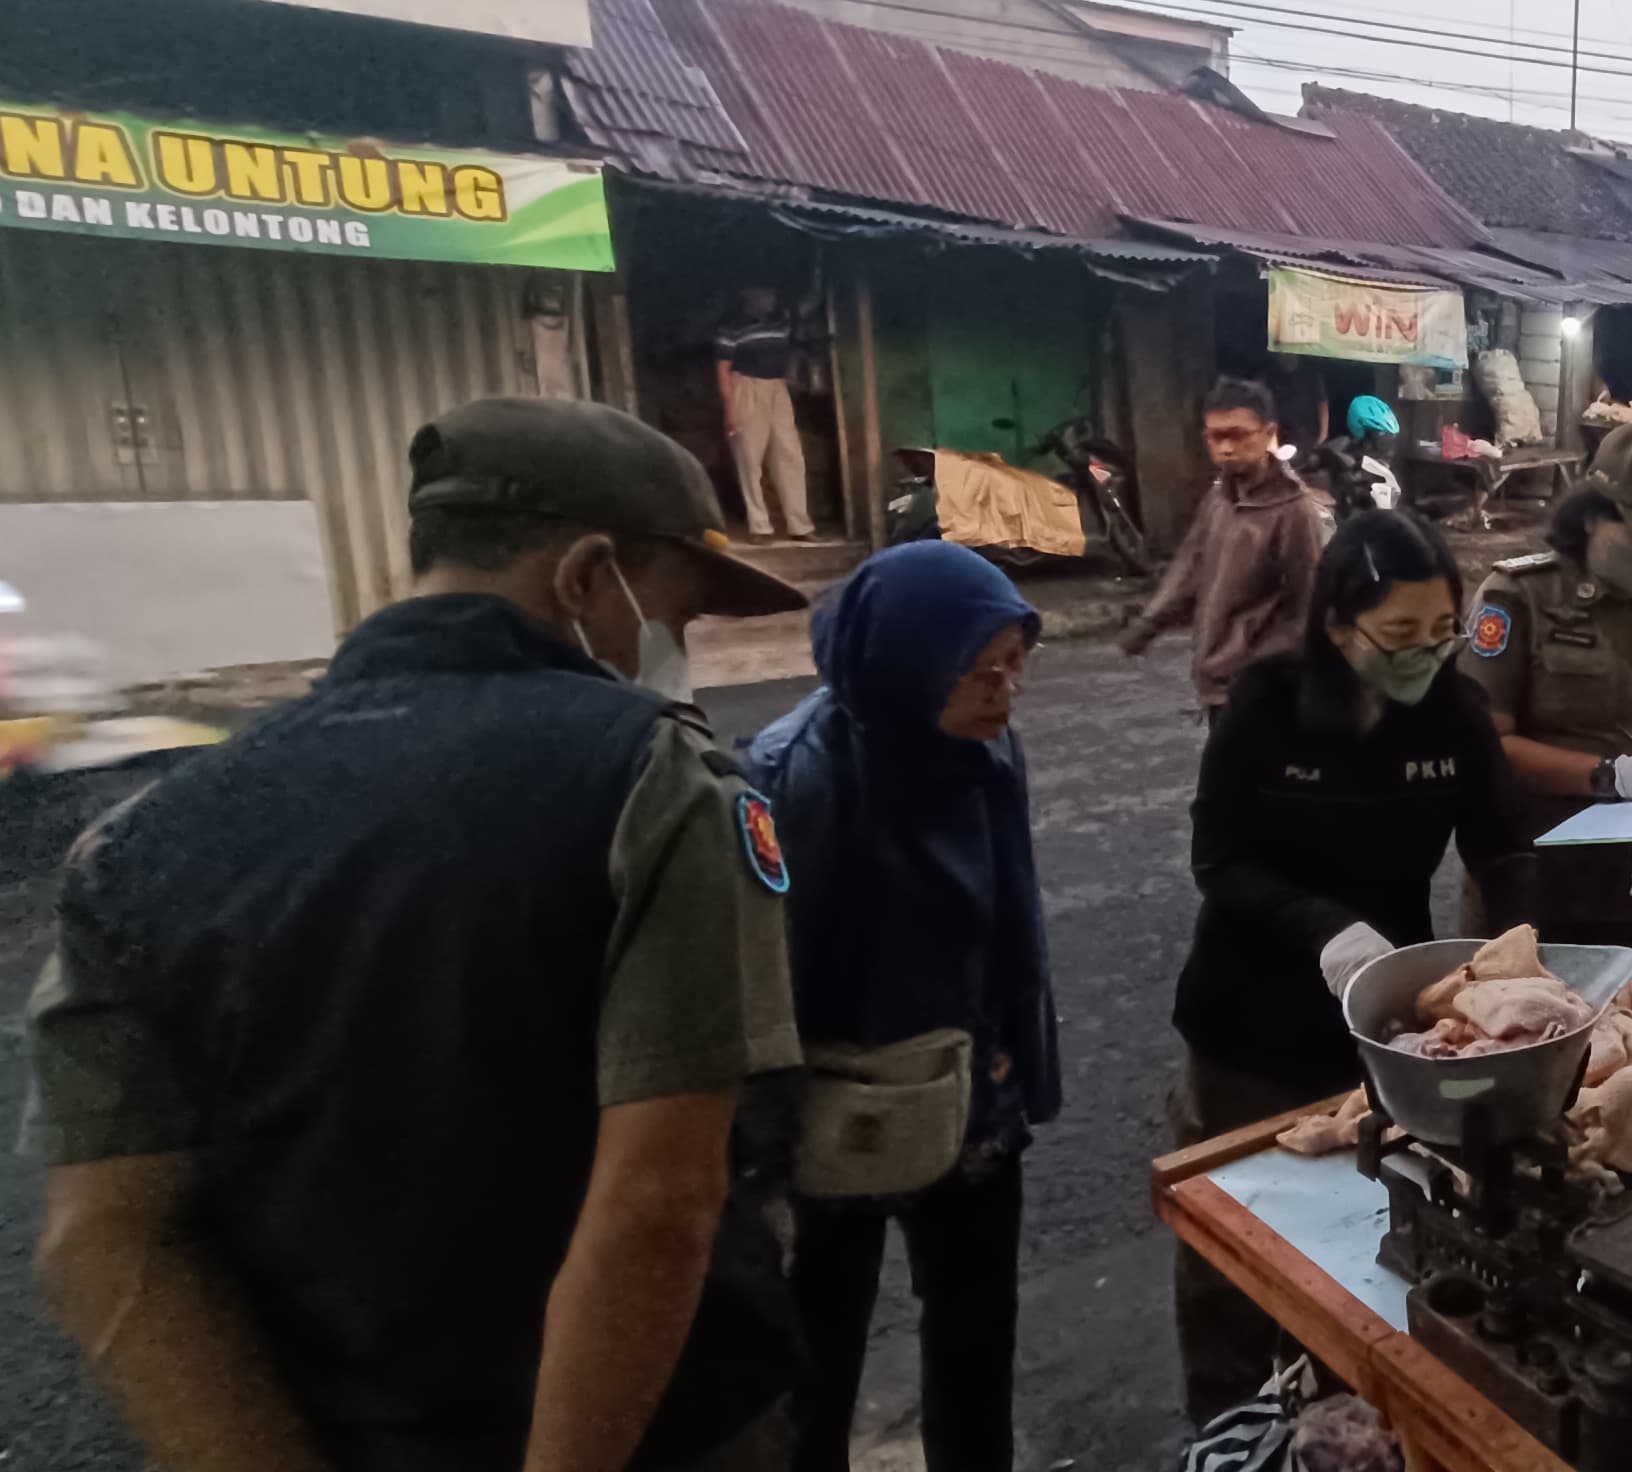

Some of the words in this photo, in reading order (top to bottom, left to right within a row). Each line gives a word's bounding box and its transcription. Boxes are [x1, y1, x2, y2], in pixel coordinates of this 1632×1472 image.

[154, 132, 507, 221] UNTUNG
[15, 190, 114, 227] DAN
[126, 201, 371, 248] KELONTONG
[1405, 757, 1456, 782] PKH
